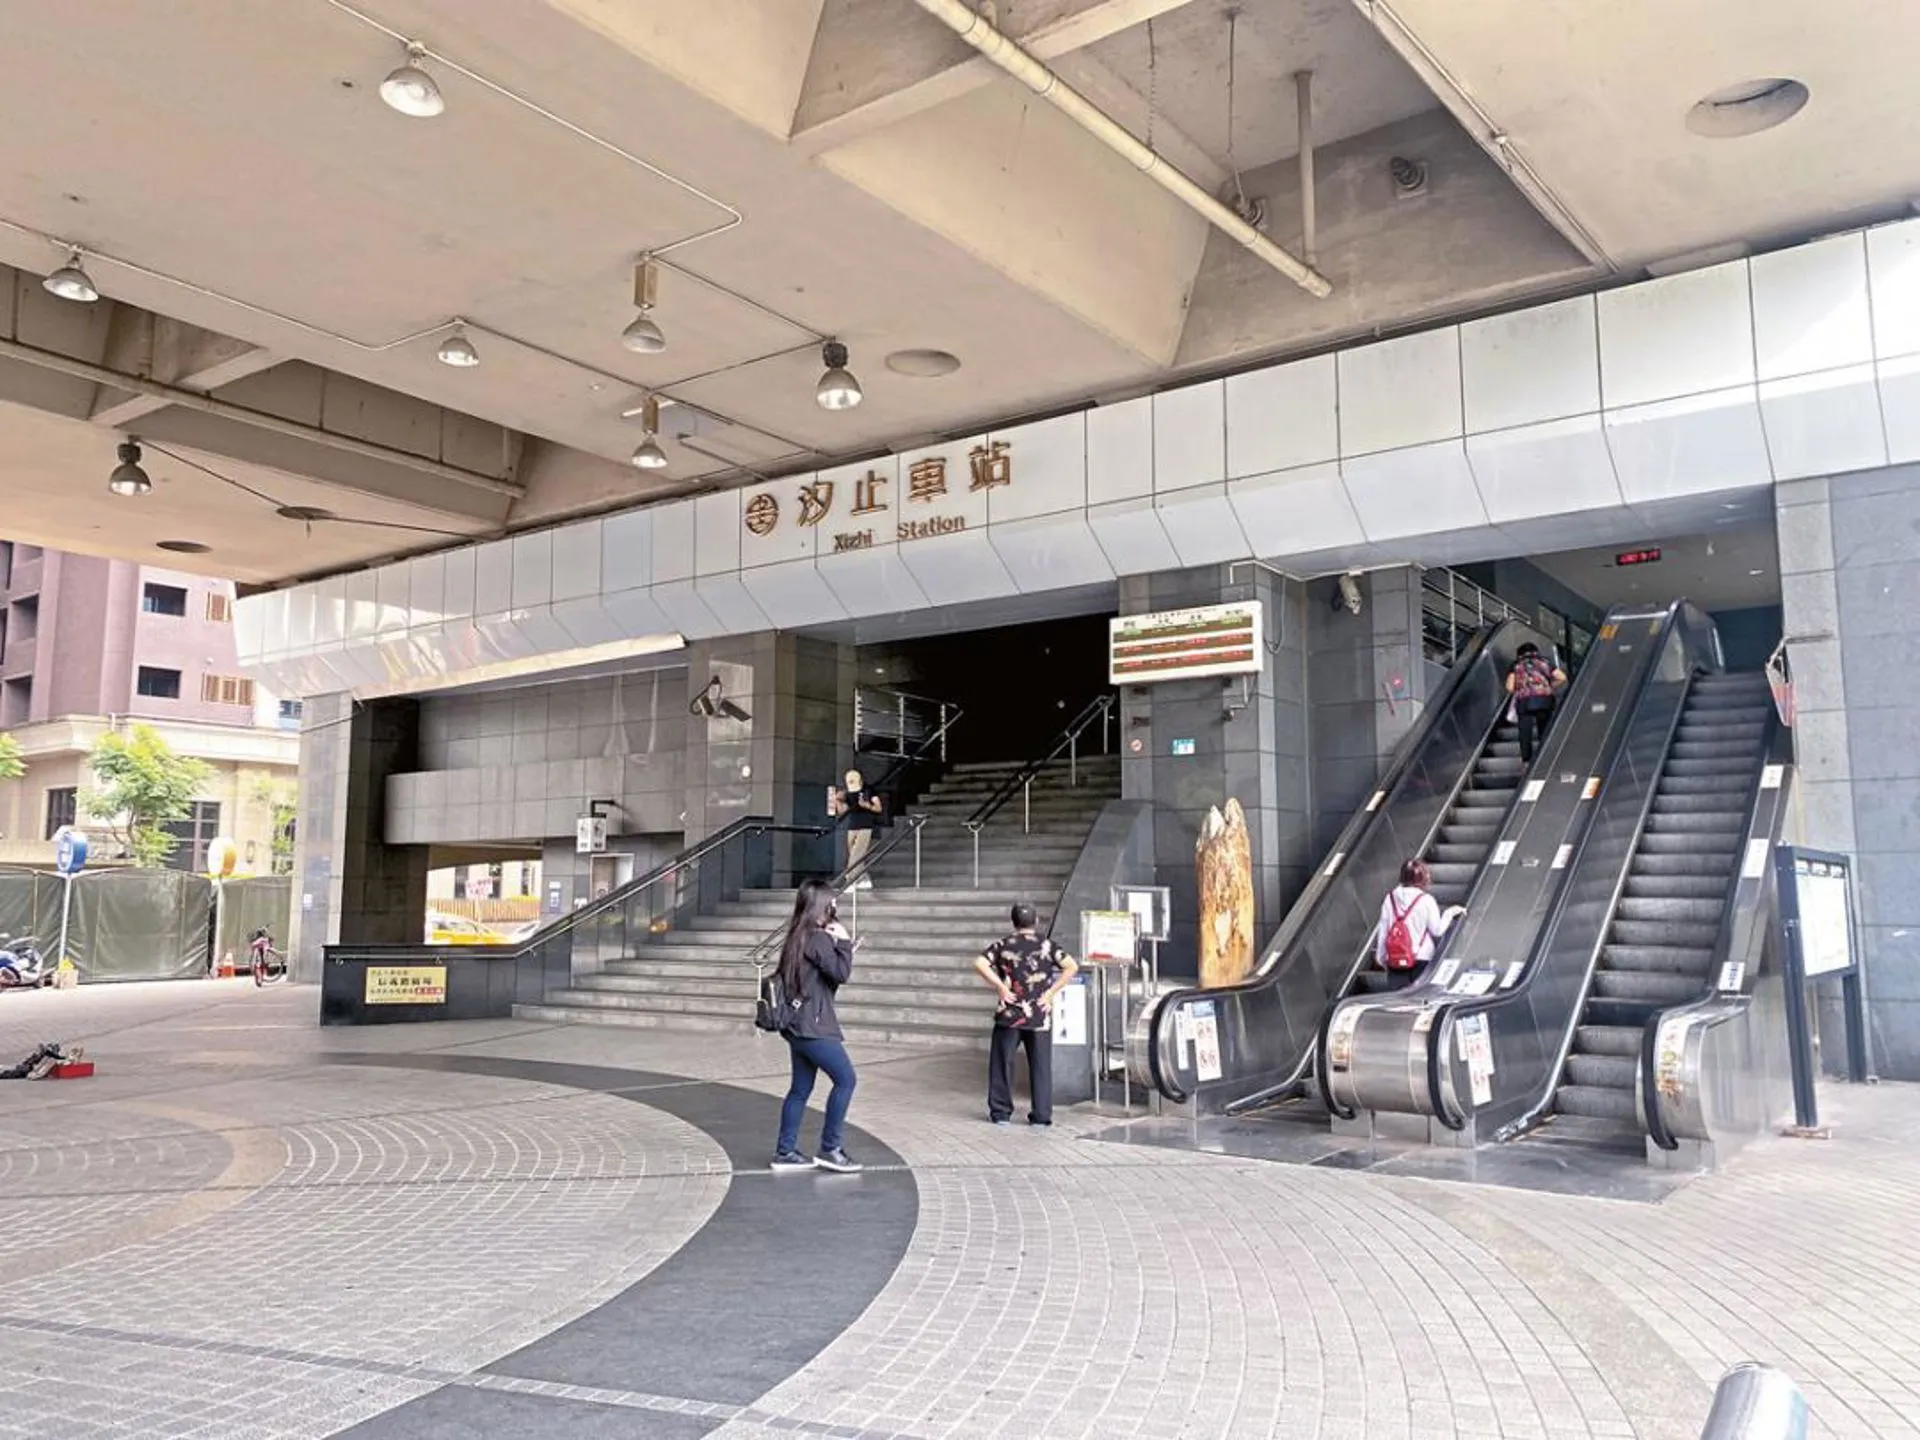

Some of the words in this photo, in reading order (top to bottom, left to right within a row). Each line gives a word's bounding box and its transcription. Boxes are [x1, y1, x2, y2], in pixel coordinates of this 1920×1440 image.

[797, 441, 1011, 527] 汐止車站
[834, 529, 873, 554] Xizhi
[897, 514, 965, 540] Station
